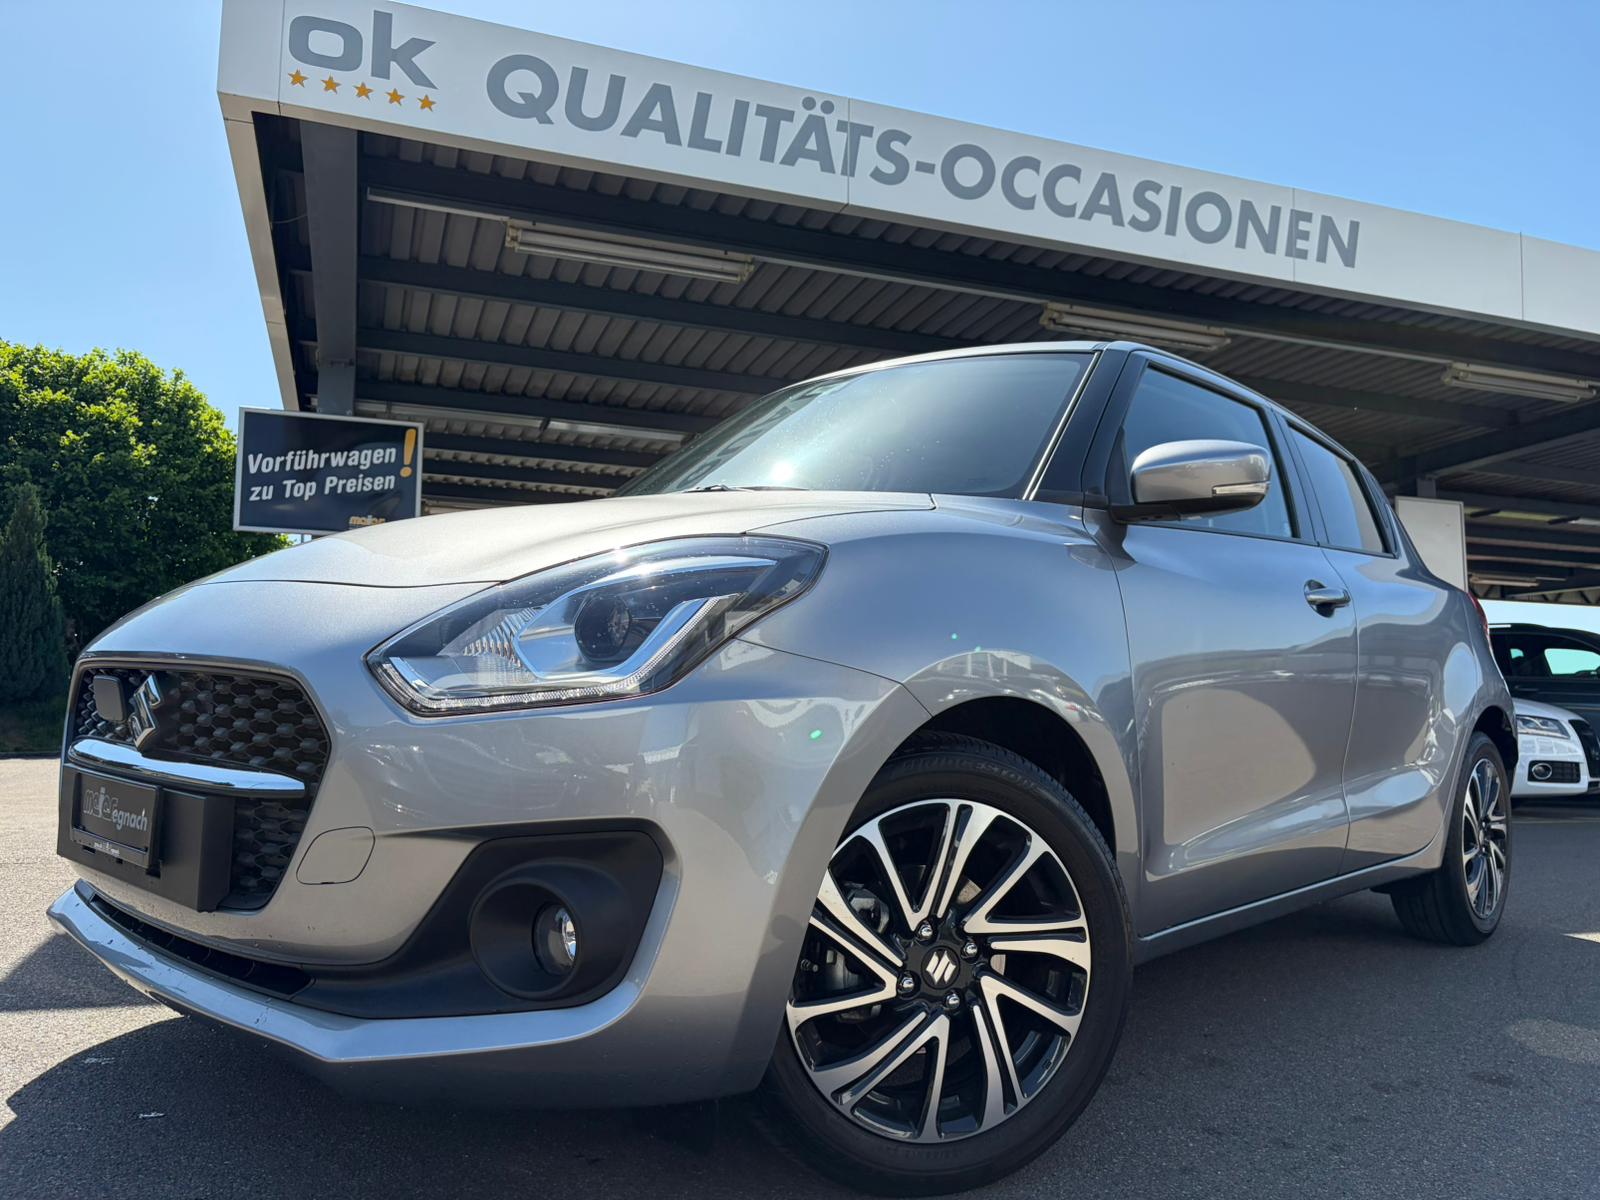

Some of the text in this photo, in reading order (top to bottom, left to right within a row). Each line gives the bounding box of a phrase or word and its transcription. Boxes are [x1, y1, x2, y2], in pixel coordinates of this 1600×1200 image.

[288, 10, 439, 90] ok
[486, 53, 1361, 269] QUALITÄTS-OCCASIONEN
[248, 447, 397, 474] Vorführwagen
[249, 474, 396, 501] zu Top Preisen
[112, 808, 149, 831] egnach
